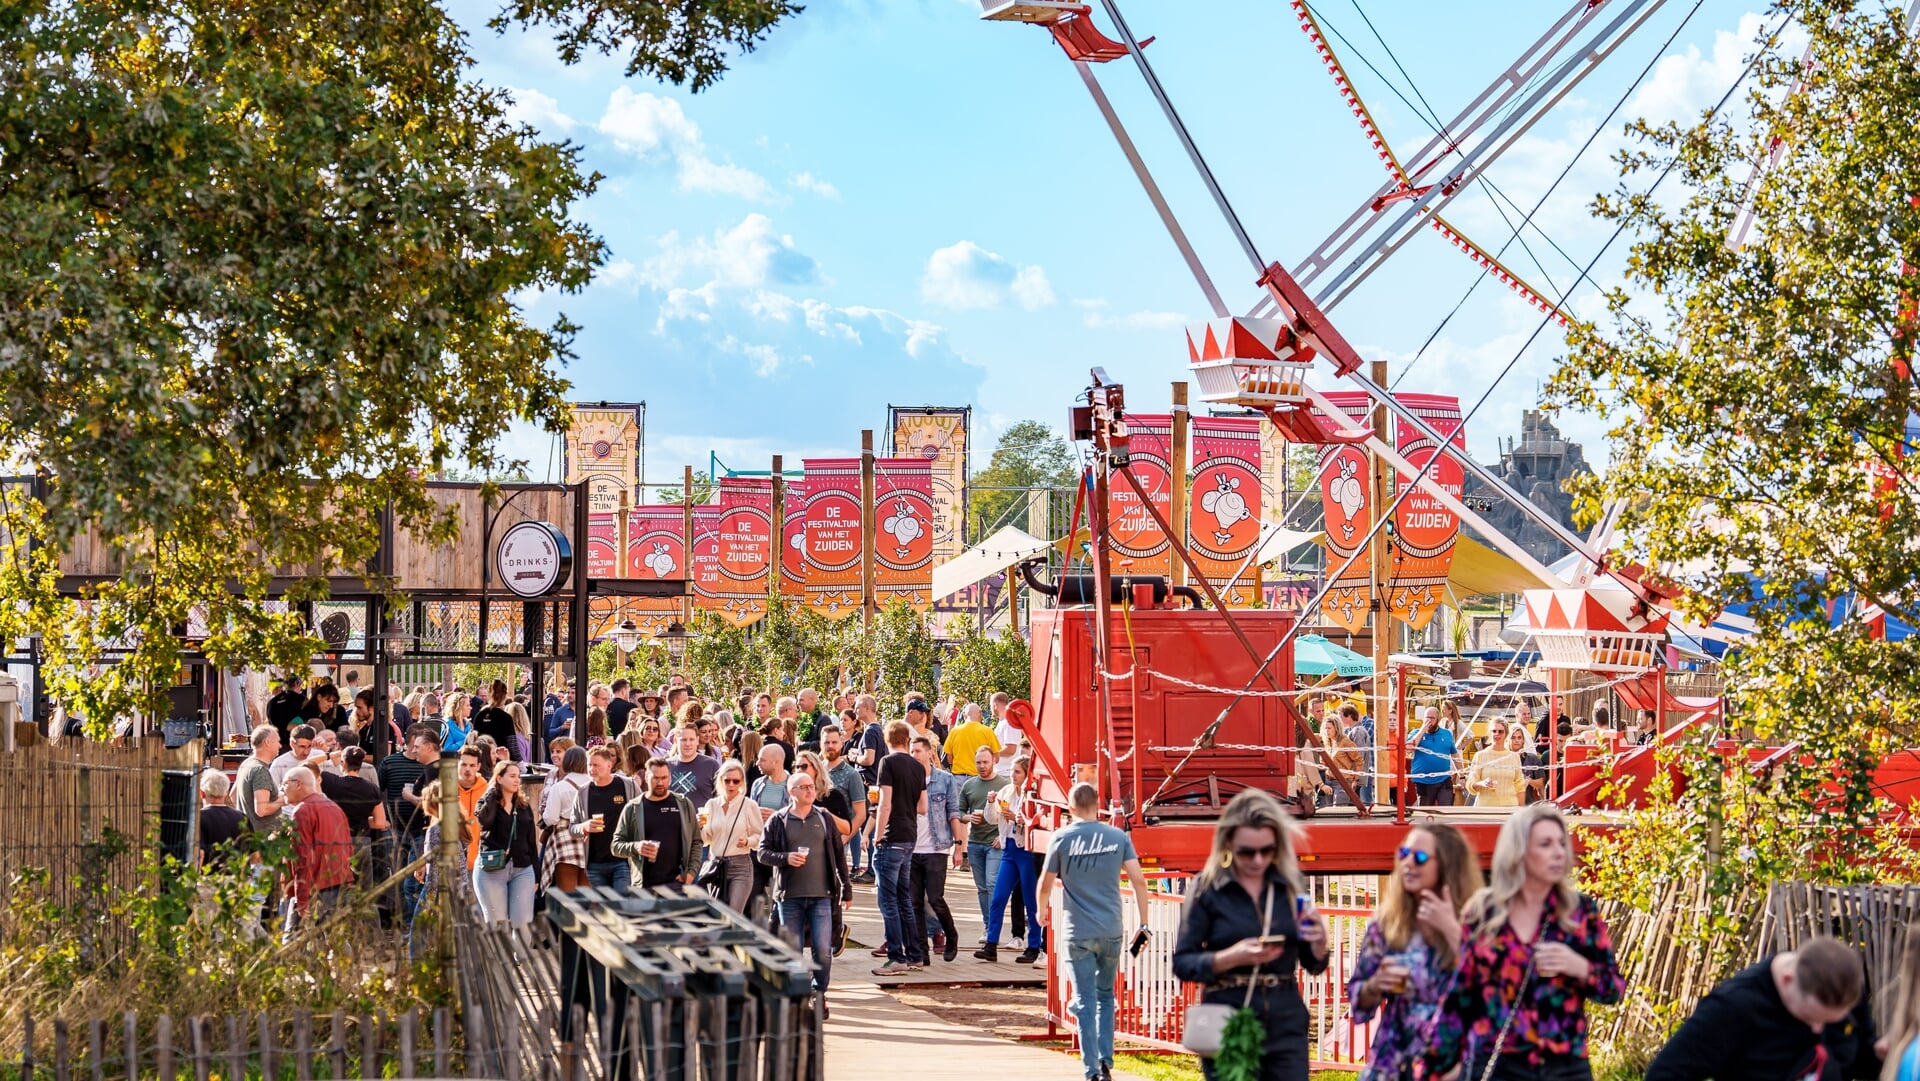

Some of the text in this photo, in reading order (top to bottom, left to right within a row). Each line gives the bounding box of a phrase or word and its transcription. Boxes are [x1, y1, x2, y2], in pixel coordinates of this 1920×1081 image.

[1399, 483, 1461, 495] FSTITUIN
[1112, 492, 1170, 502] FESTILTUIN
[1410, 499, 1449, 510] VAN HE
[826, 507, 840, 517] DE
[1123, 506, 1141, 515] VAN
[808, 520, 859, 528] FESTIVALTUIN
[1405, 513, 1451, 528] ZUIDEN
[738, 522, 751, 532] DE
[721, 534, 769, 542] FESTIVALTUIN
[712, 544, 719, 553] D
[729, 543, 759, 551] VAN HET
[814, 540, 853, 551] ZUIDEN
[588, 550, 598, 558] DE
[726, 552, 762, 562] ZUIDEN
[509, 558, 548, 567] DRINKS
[1341, 665, 1373, 673] FEVER-TRE
